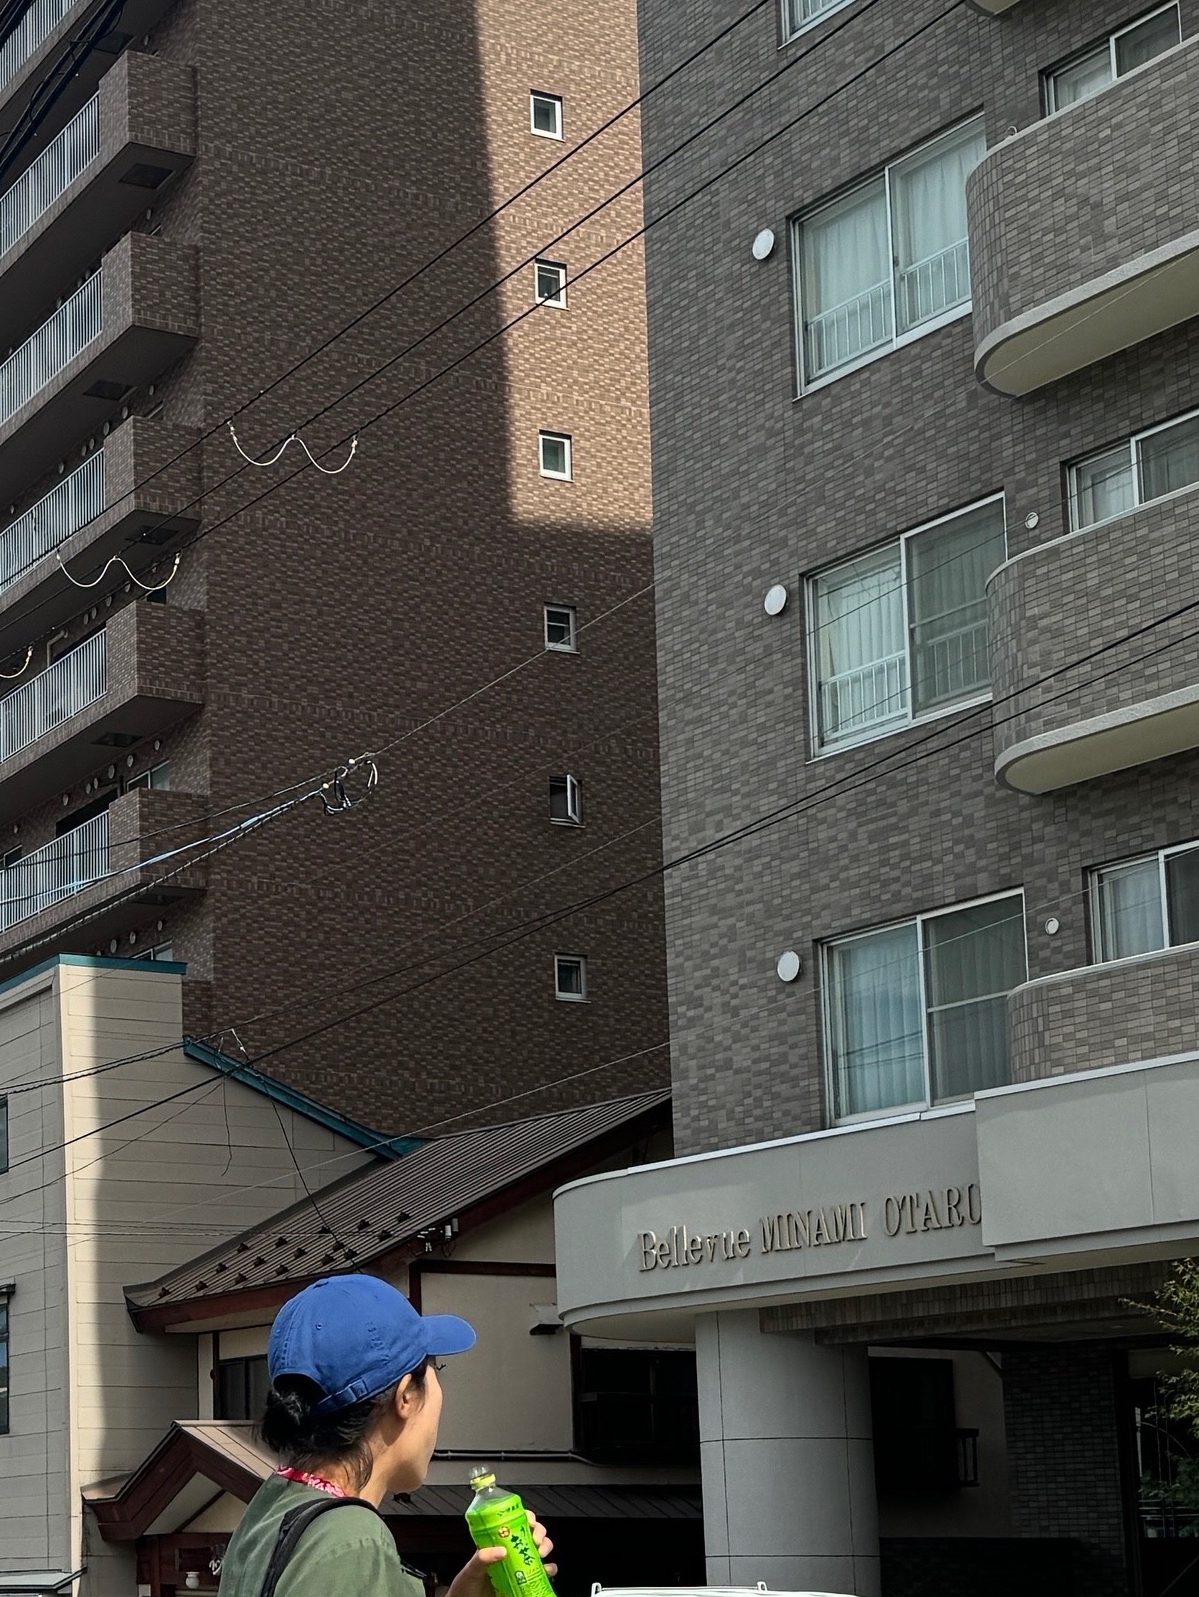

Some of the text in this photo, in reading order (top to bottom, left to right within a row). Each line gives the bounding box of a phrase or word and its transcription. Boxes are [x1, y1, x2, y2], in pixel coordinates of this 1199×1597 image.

[638, 1183, 982, 1272] Bellevue MINAMI OTARU
